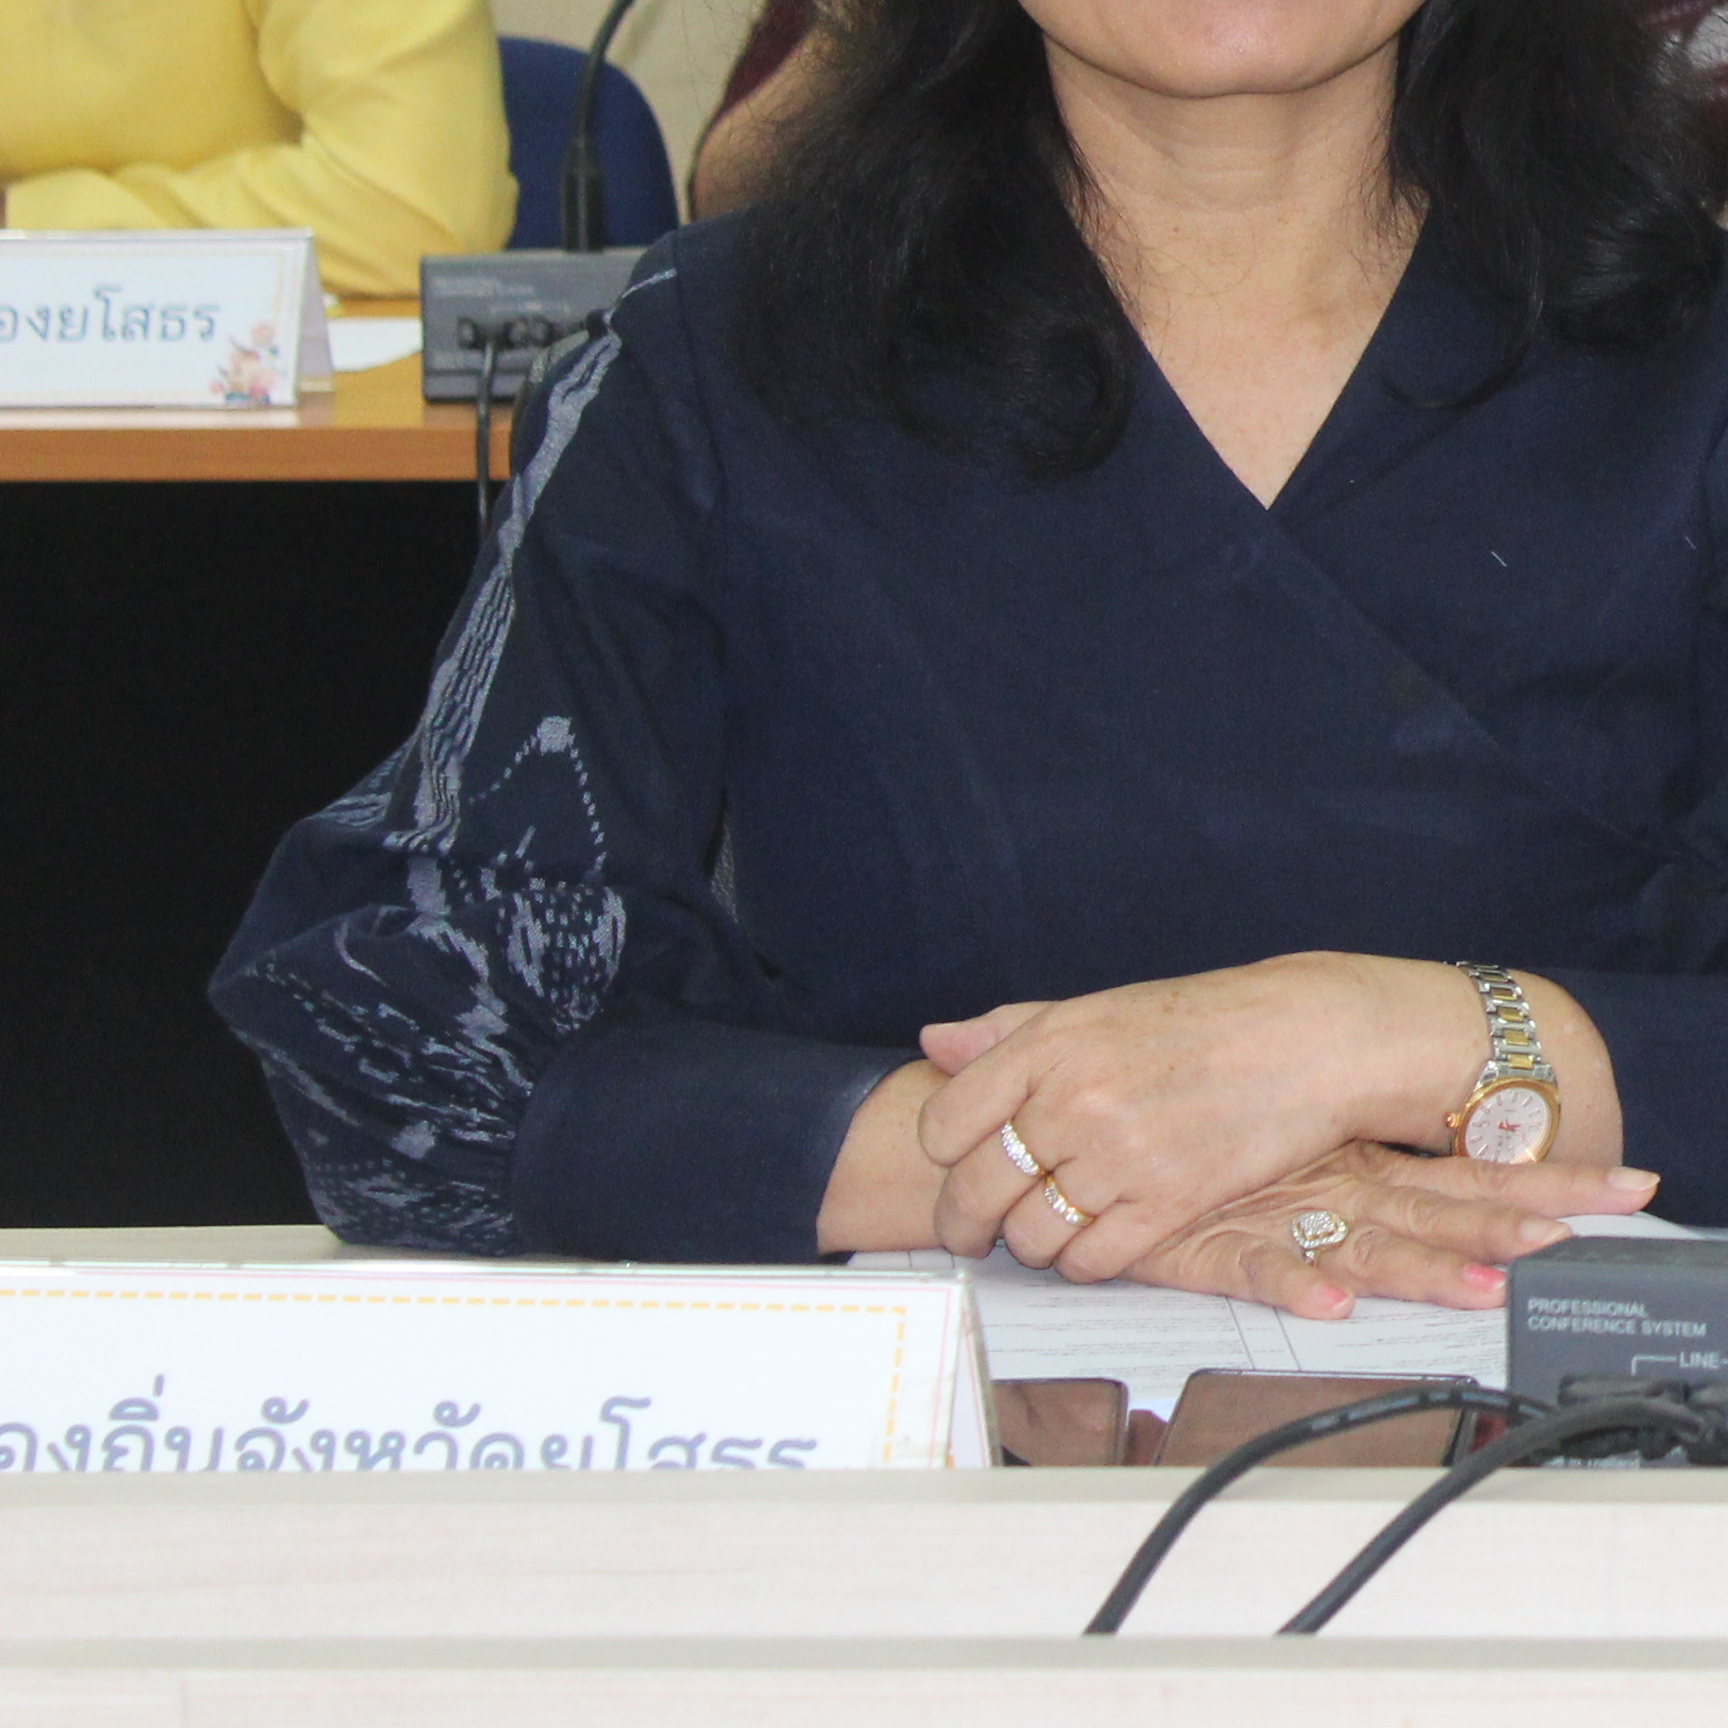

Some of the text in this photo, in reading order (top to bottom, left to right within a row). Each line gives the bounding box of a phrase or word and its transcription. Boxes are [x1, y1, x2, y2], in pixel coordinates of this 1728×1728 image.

[1527, 1296, 1650, 1319] PROFESSIONAL
[1527, 1315, 1708, 1338] CONFERENCE SYSTEM
[1679, 1350, 1722, 1370] LINE
